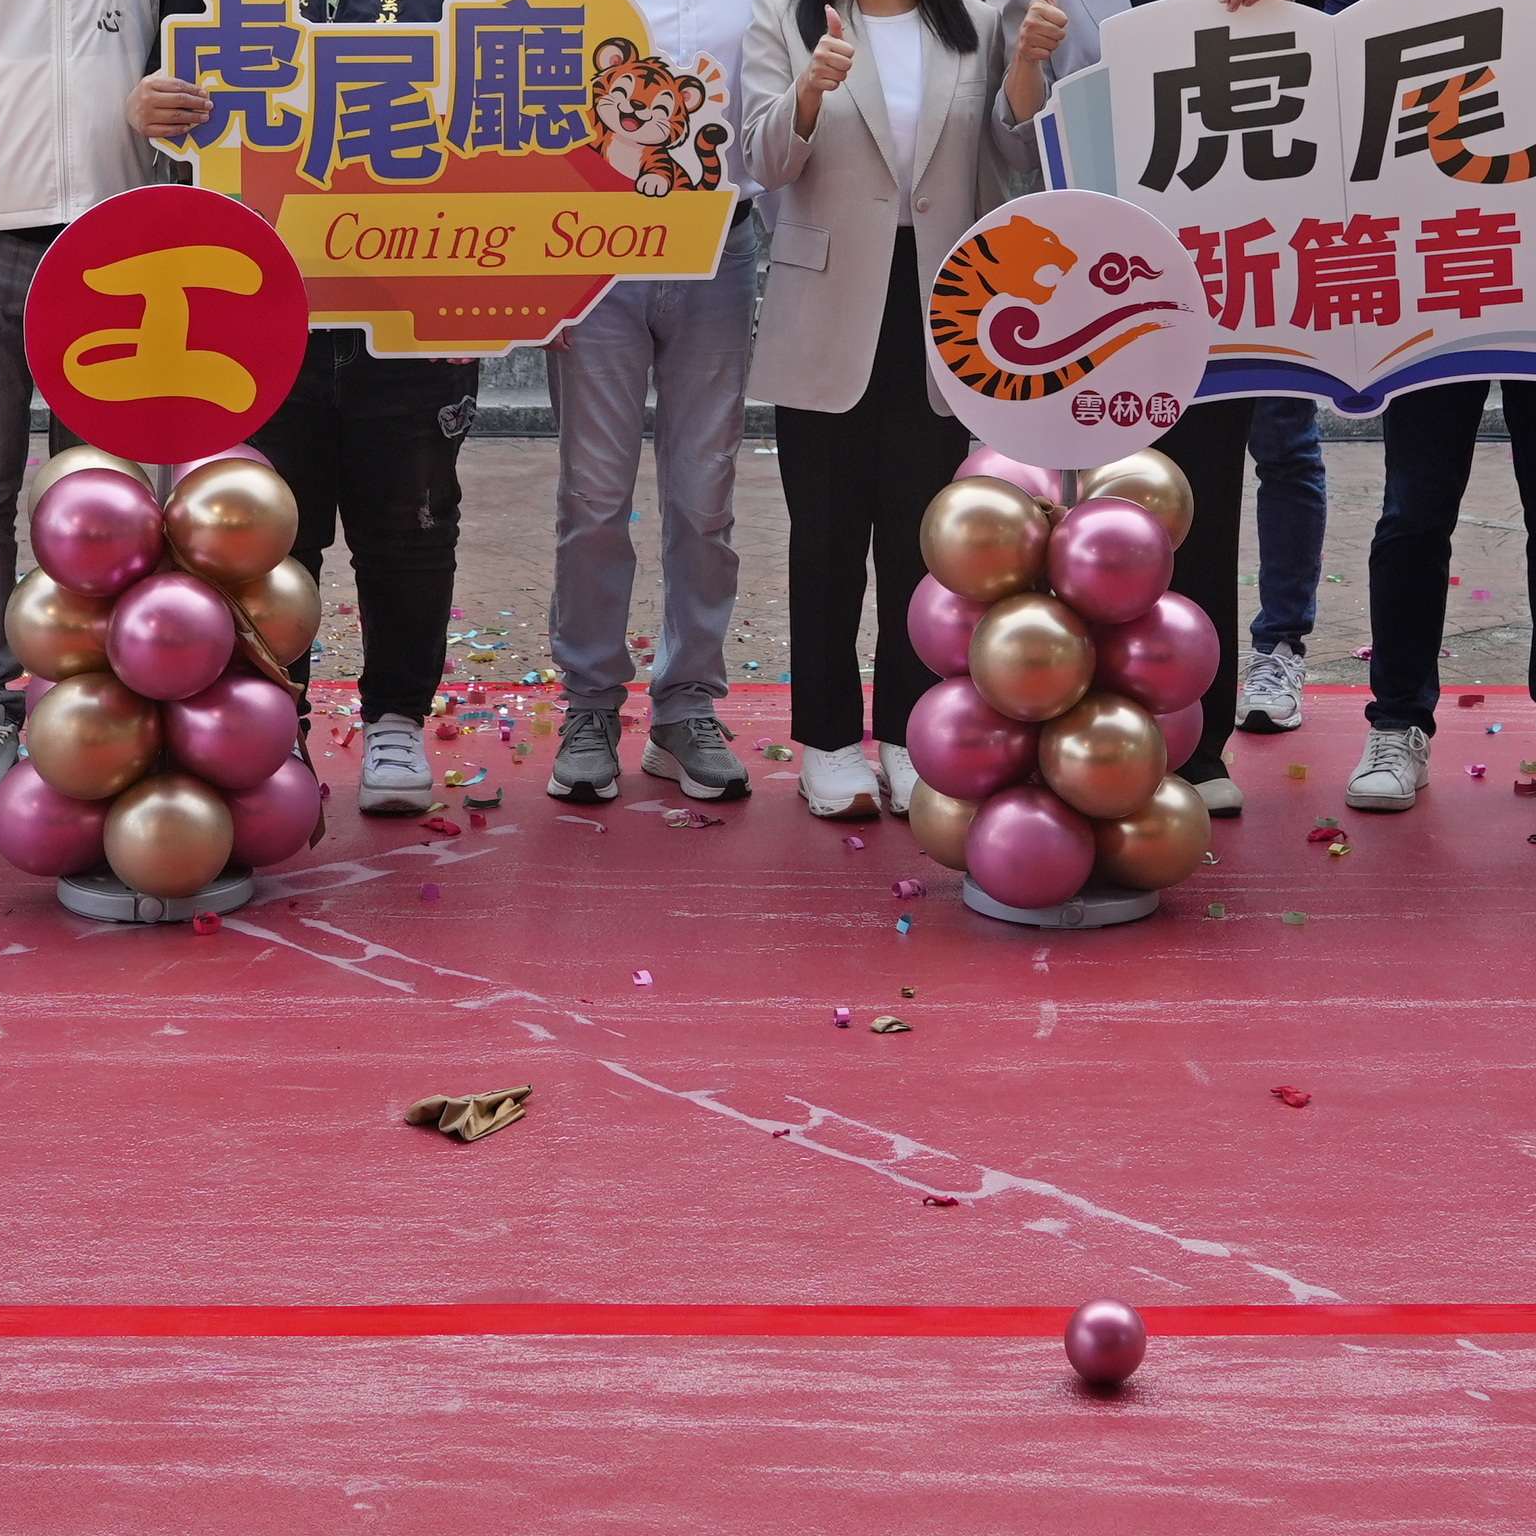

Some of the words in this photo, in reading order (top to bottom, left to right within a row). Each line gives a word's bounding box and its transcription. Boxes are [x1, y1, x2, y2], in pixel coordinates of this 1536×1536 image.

[324, 211, 516, 268] Coming
[545, 211, 669, 258] Soon
[1176, 206, 1524, 332] 新篇章
[63, 245, 263, 414] 工
[1073, 391, 1180, 427] 雲林縣
